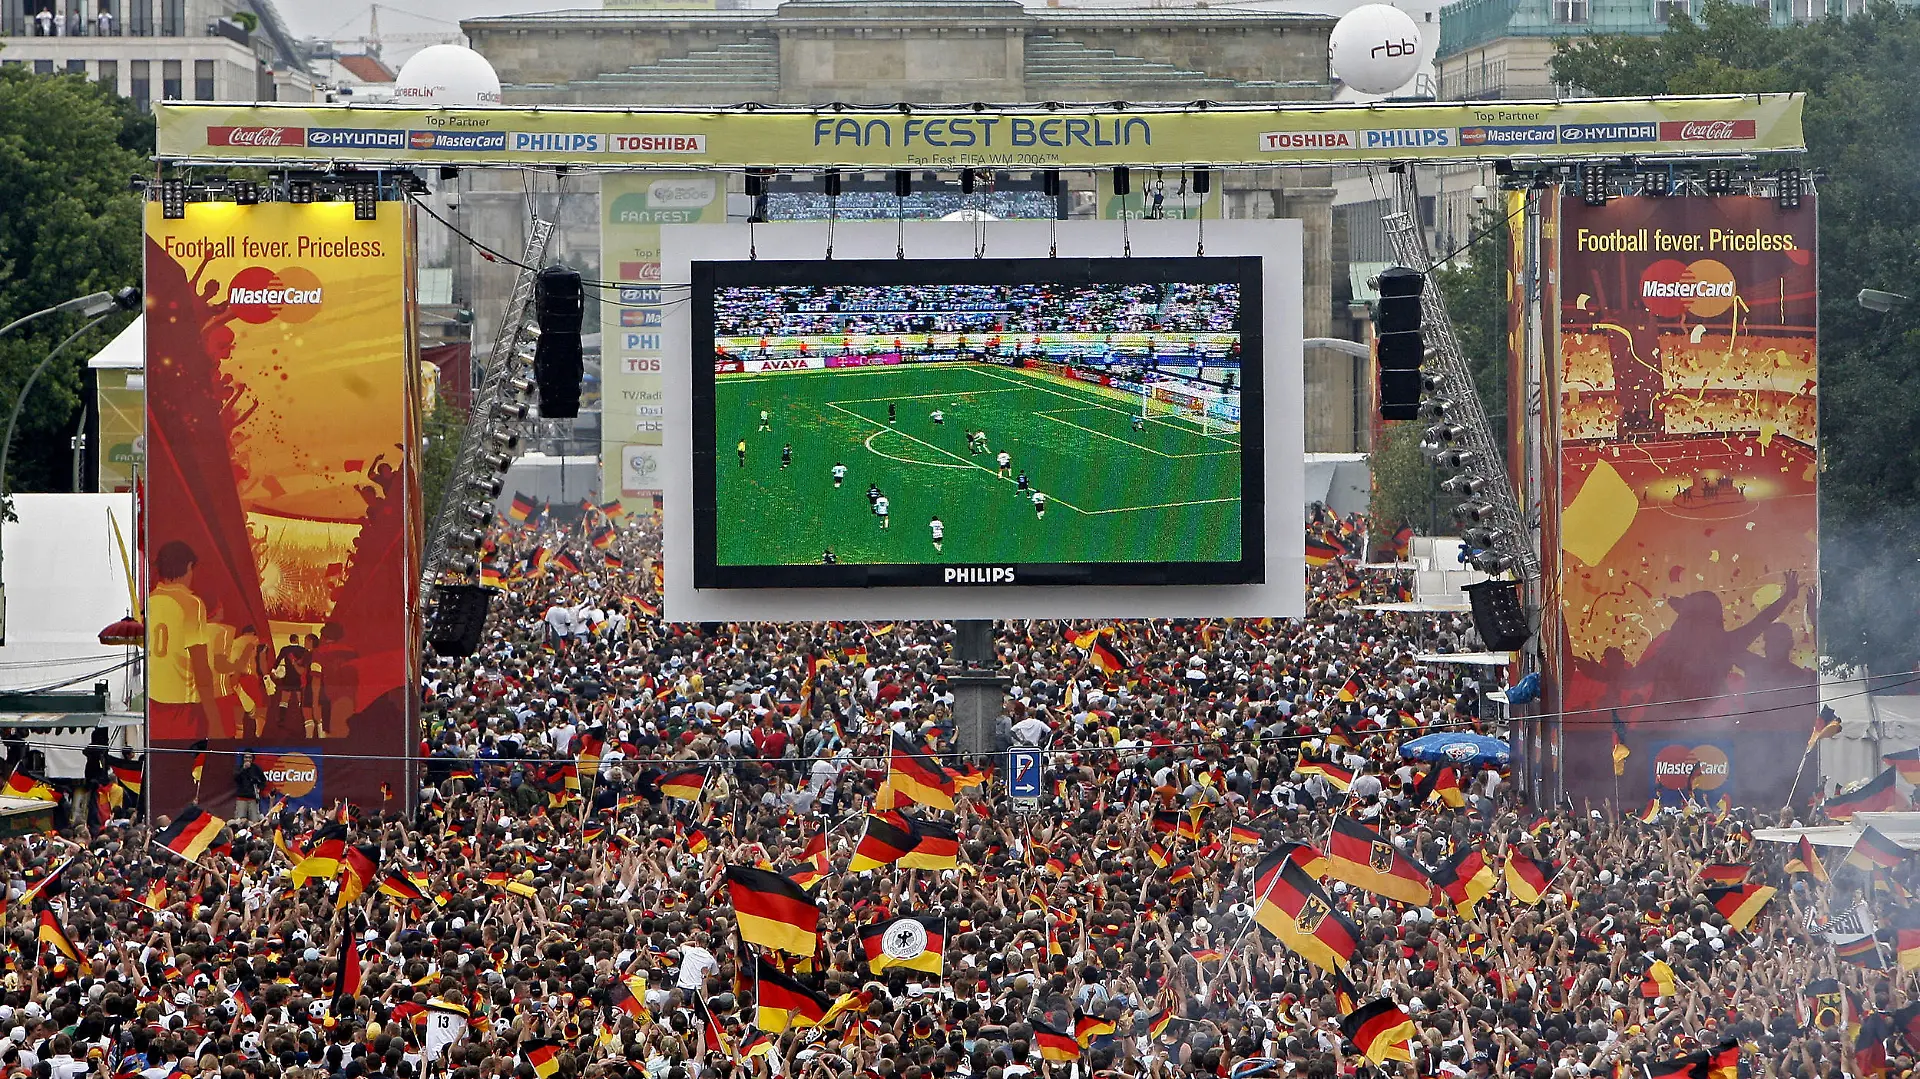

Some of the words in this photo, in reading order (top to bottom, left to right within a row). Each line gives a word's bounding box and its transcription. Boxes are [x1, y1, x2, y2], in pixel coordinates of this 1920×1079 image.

[1371, 38, 1415, 59] rbb
[426, 115, 446, 127] Top
[449, 116, 490, 127] Partner
[1474, 111, 1495, 122] Top
[1498, 111, 1539, 121] Partner
[229, 127, 284, 146] Coca-Cola
[814, 119, 891, 147] FAN
[904, 118, 999, 147] FEST
[1012, 117, 1151, 147] BERLIN
[1367, 129, 1449, 147] PHILIPS
[1488, 129, 1555, 141] MasterCard
[1585, 126, 1655, 140] HYUNDAI
[1681, 121, 1736, 140] Coca-Cola
[332, 132, 404, 145] HYUNDAI
[436, 135, 505, 147] MasterCard
[516, 134, 598, 150] PHILIPS
[616, 137, 698, 150] TOSHIBA
[1267, 133, 1349, 148] TOSHIBA
[907, 154, 927, 164] Fan
[932, 154, 956, 164] Fest
[960, 154, 986, 164] FIFA
[989, 154, 1013, 164] WM
[621, 211, 649, 222] FAN
[654, 211, 691, 222] FEST
[164, 235, 235, 258] Football
[242, 236, 292, 258] fever.
[298, 235, 385, 258] Priceless.
[1578, 228, 1648, 252] Football
[1654, 229, 1704, 251] fever.
[1709, 228, 1798, 251] Priceless.
[635, 248, 653, 259] Top
[230, 287, 322, 304] MasterCard
[1642, 280, 1734, 298] MasterCard
[628, 334, 660, 349] PHI
[628, 359, 660, 371] TOS
[761, 359, 809, 370] AVAYA
[944, 567, 1015, 583] PHILIPS
[263, 768, 316, 782] sterCard
[1016, 754, 1034, 781] P
[1656, 761, 1728, 775] MasteCard
[437, 1014, 450, 1029] 13
